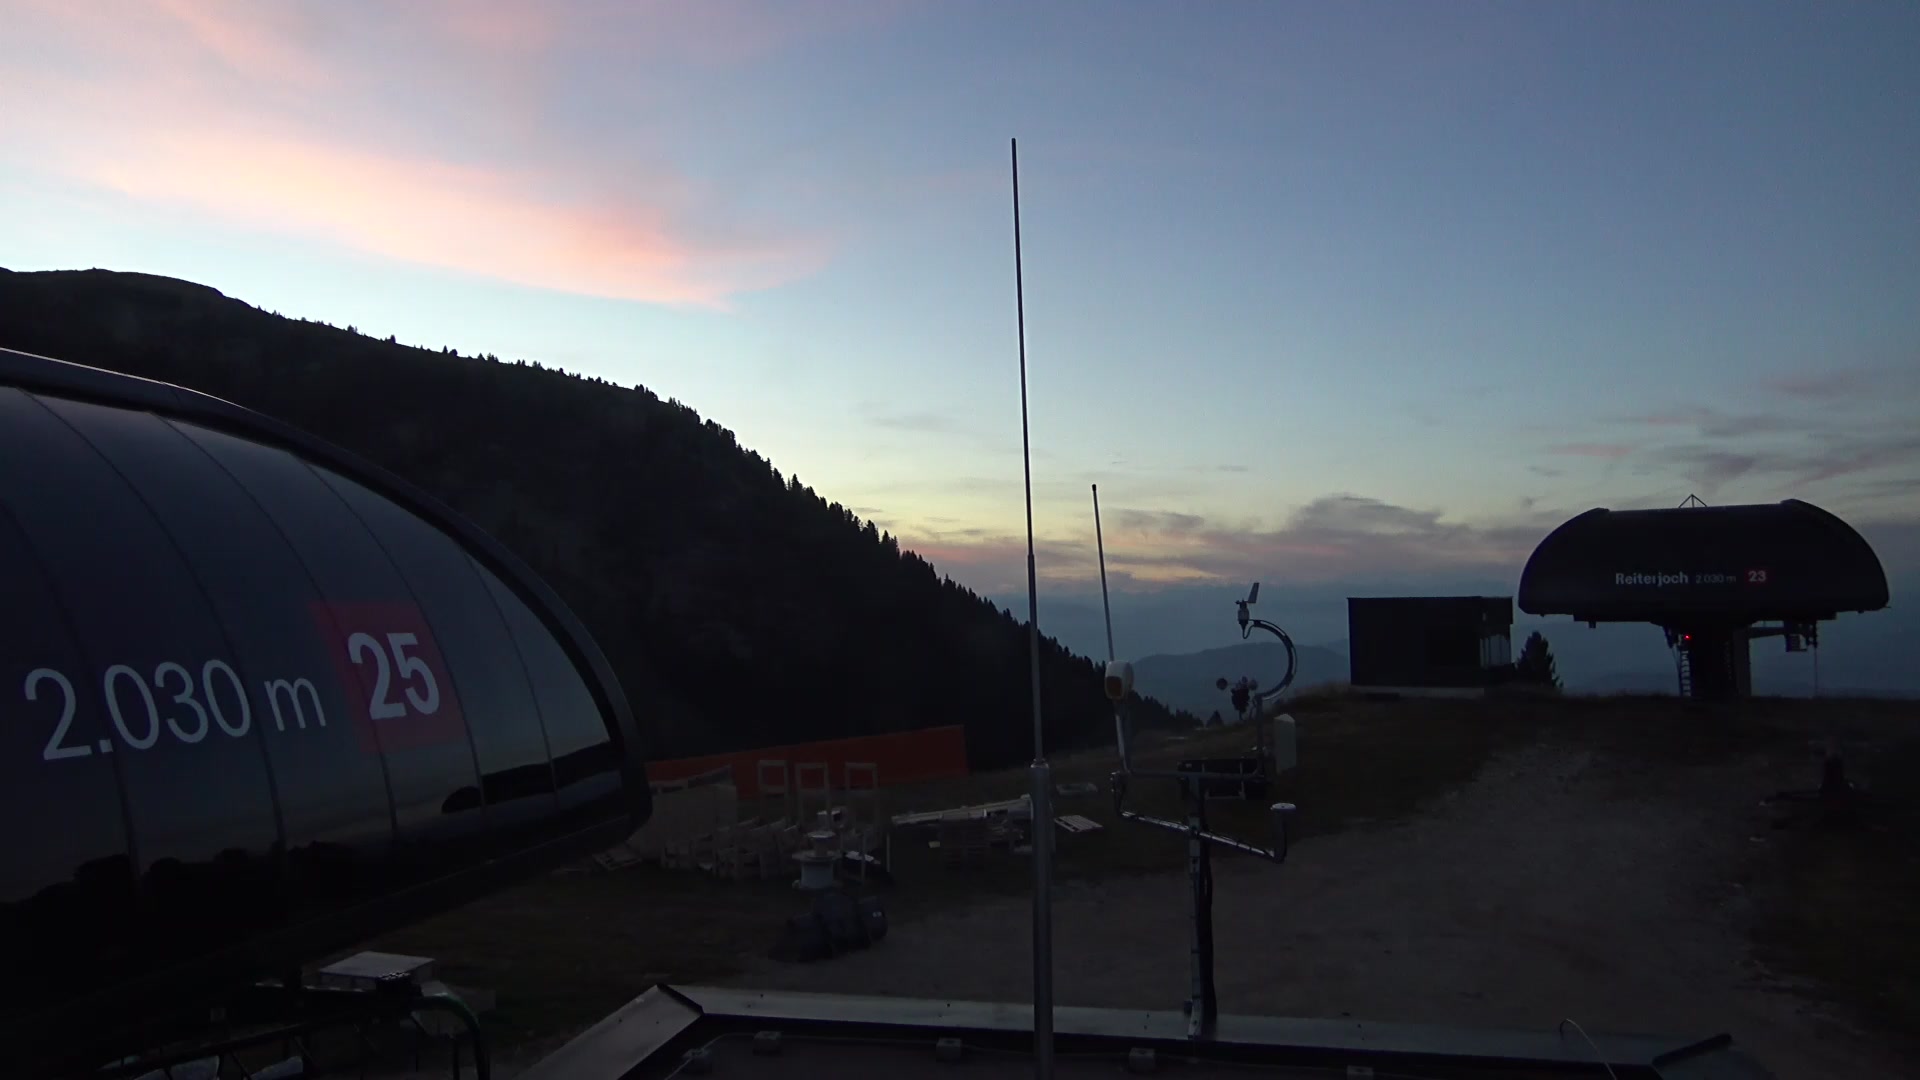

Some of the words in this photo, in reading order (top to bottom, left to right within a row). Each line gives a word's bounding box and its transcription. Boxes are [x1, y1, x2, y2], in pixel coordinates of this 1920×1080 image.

[1615, 571, 1689, 587] Reiterjoch
[1748, 570, 1767, 583] 23
[24, 659, 251, 760] 2.030
[264, 678, 326, 731] m
[347, 632, 440, 720] 25
